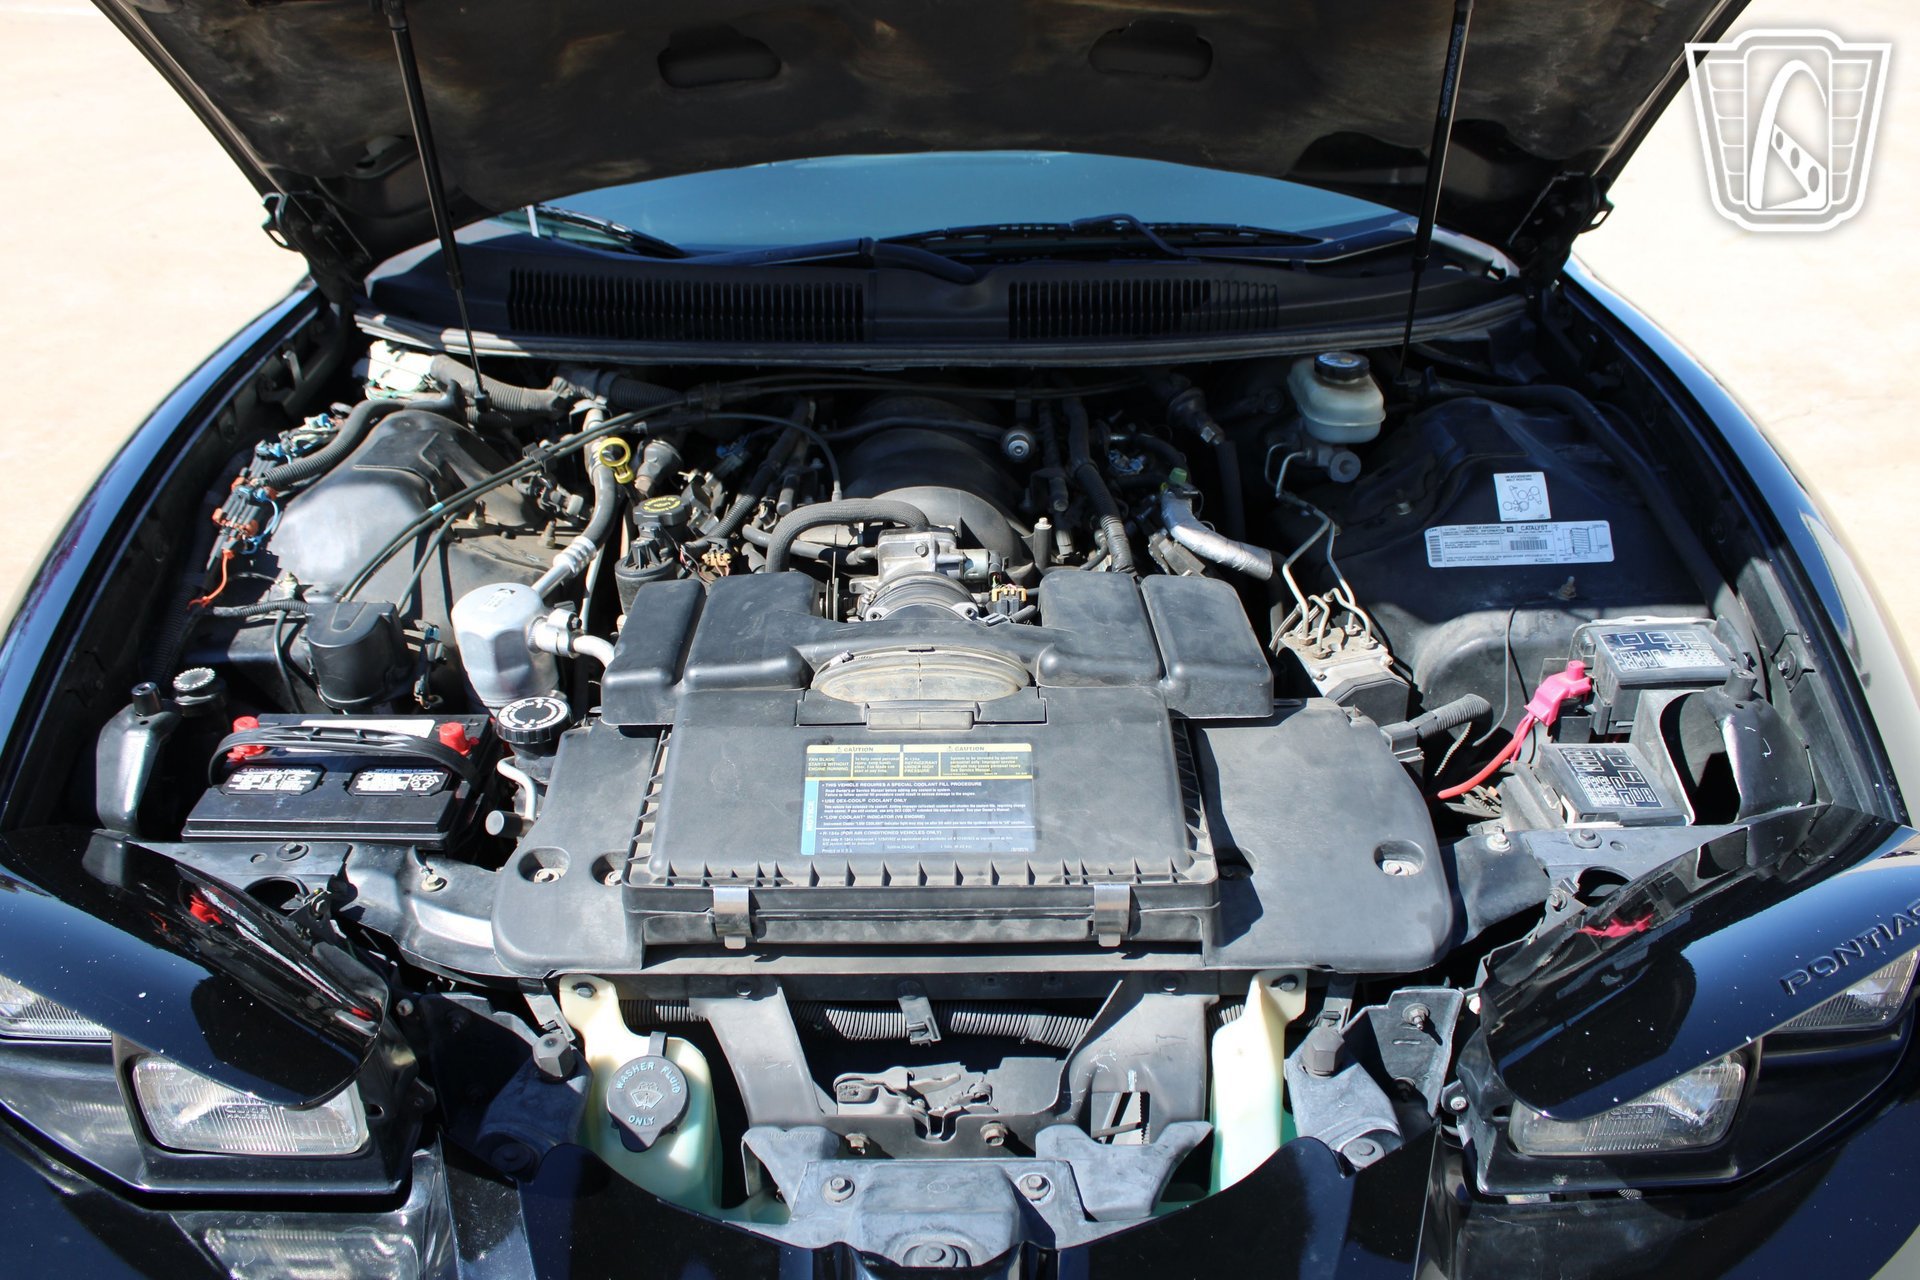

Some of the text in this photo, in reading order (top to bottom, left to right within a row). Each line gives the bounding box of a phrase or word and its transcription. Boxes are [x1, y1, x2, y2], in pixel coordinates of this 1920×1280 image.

[616, 1061, 681, 1094] WASHER FLUID
[628, 1114, 656, 1126] ONLY
